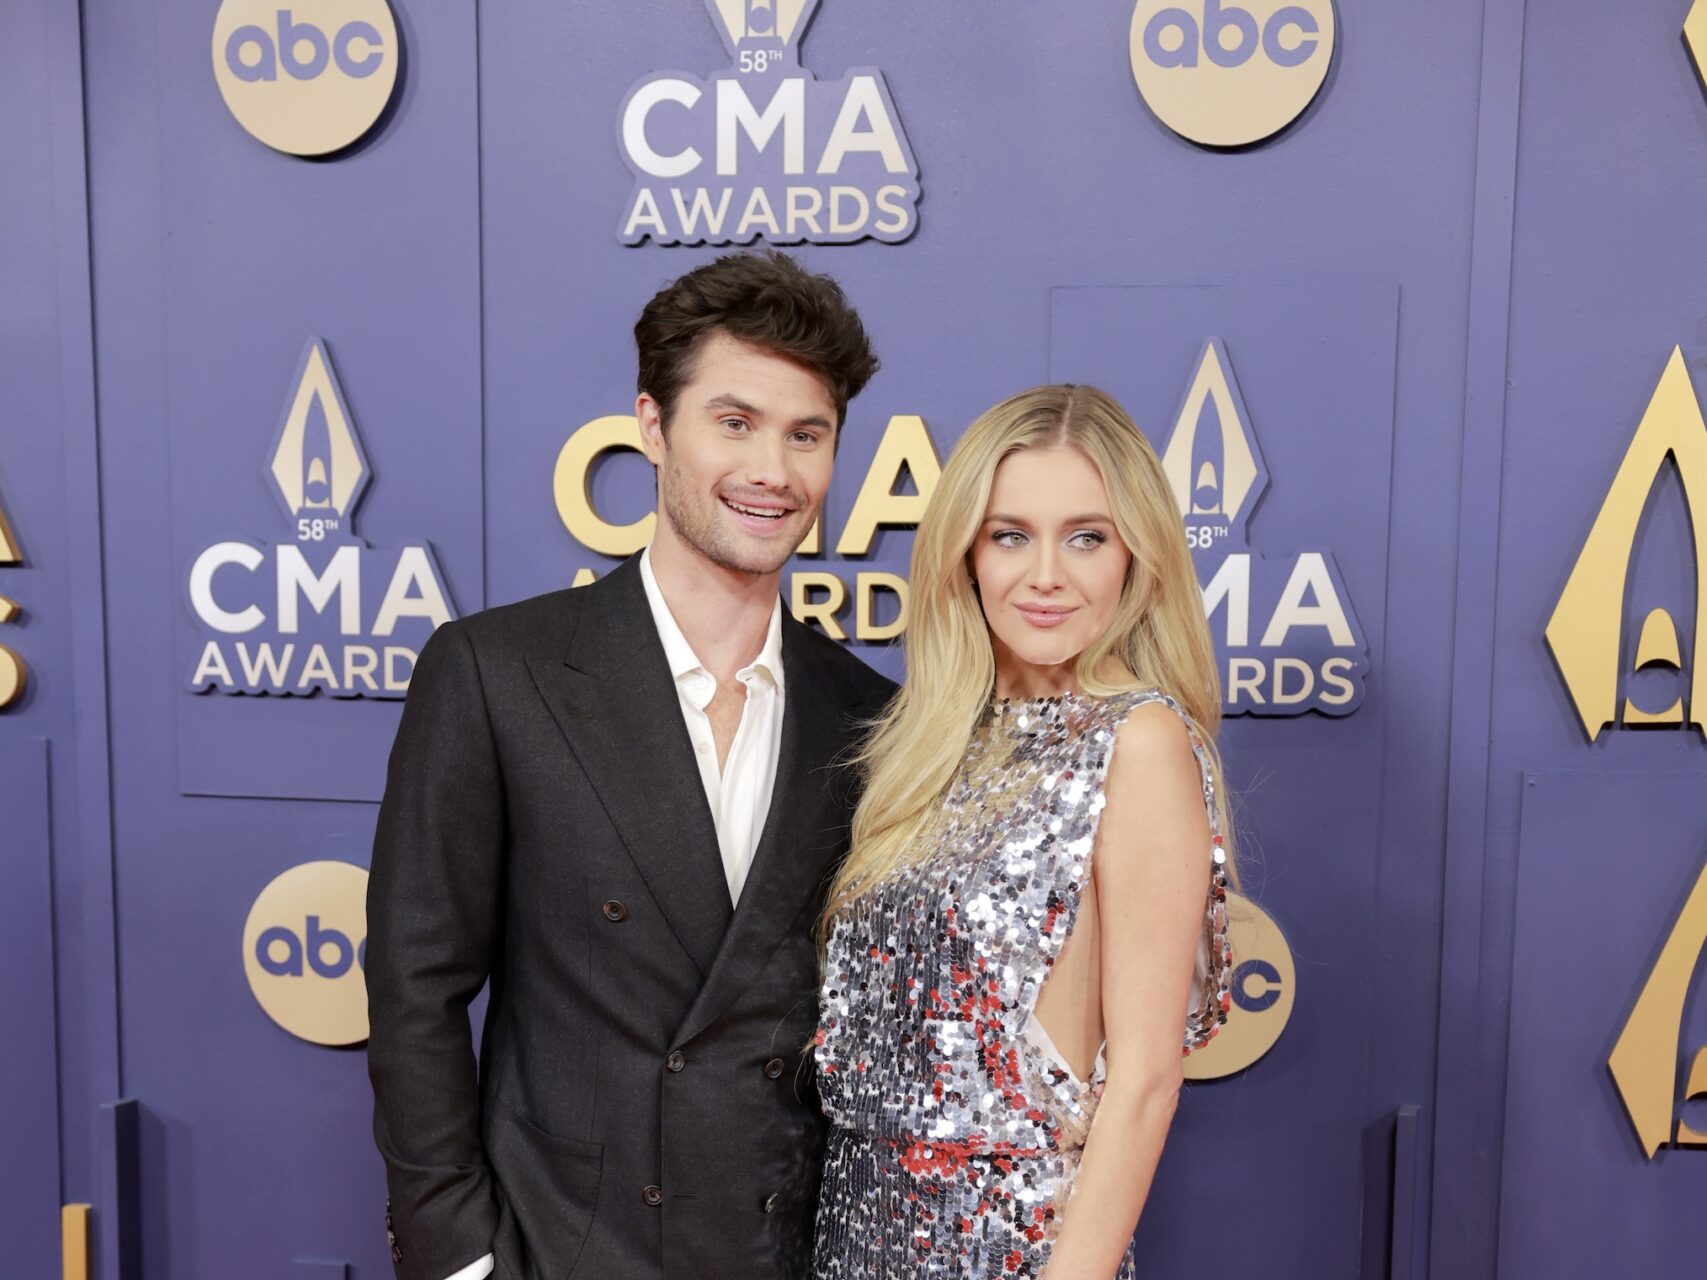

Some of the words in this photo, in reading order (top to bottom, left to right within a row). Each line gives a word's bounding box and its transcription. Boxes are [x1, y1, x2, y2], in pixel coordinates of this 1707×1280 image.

[224, 10, 385, 82] abc
[739, 49, 783, 73] 58TH
[1143, 0, 1319, 68] abc
[621, 75, 910, 178] CMA
[622, 184, 909, 234] AWARDS
[553, 415, 944, 555] CA
[297, 519, 339, 541] 58TH
[189, 541, 453, 637] CMA
[1198, 552, 1356, 647] MA
[191, 641, 418, 692] AWARD
[255, 914, 368, 979] ab
